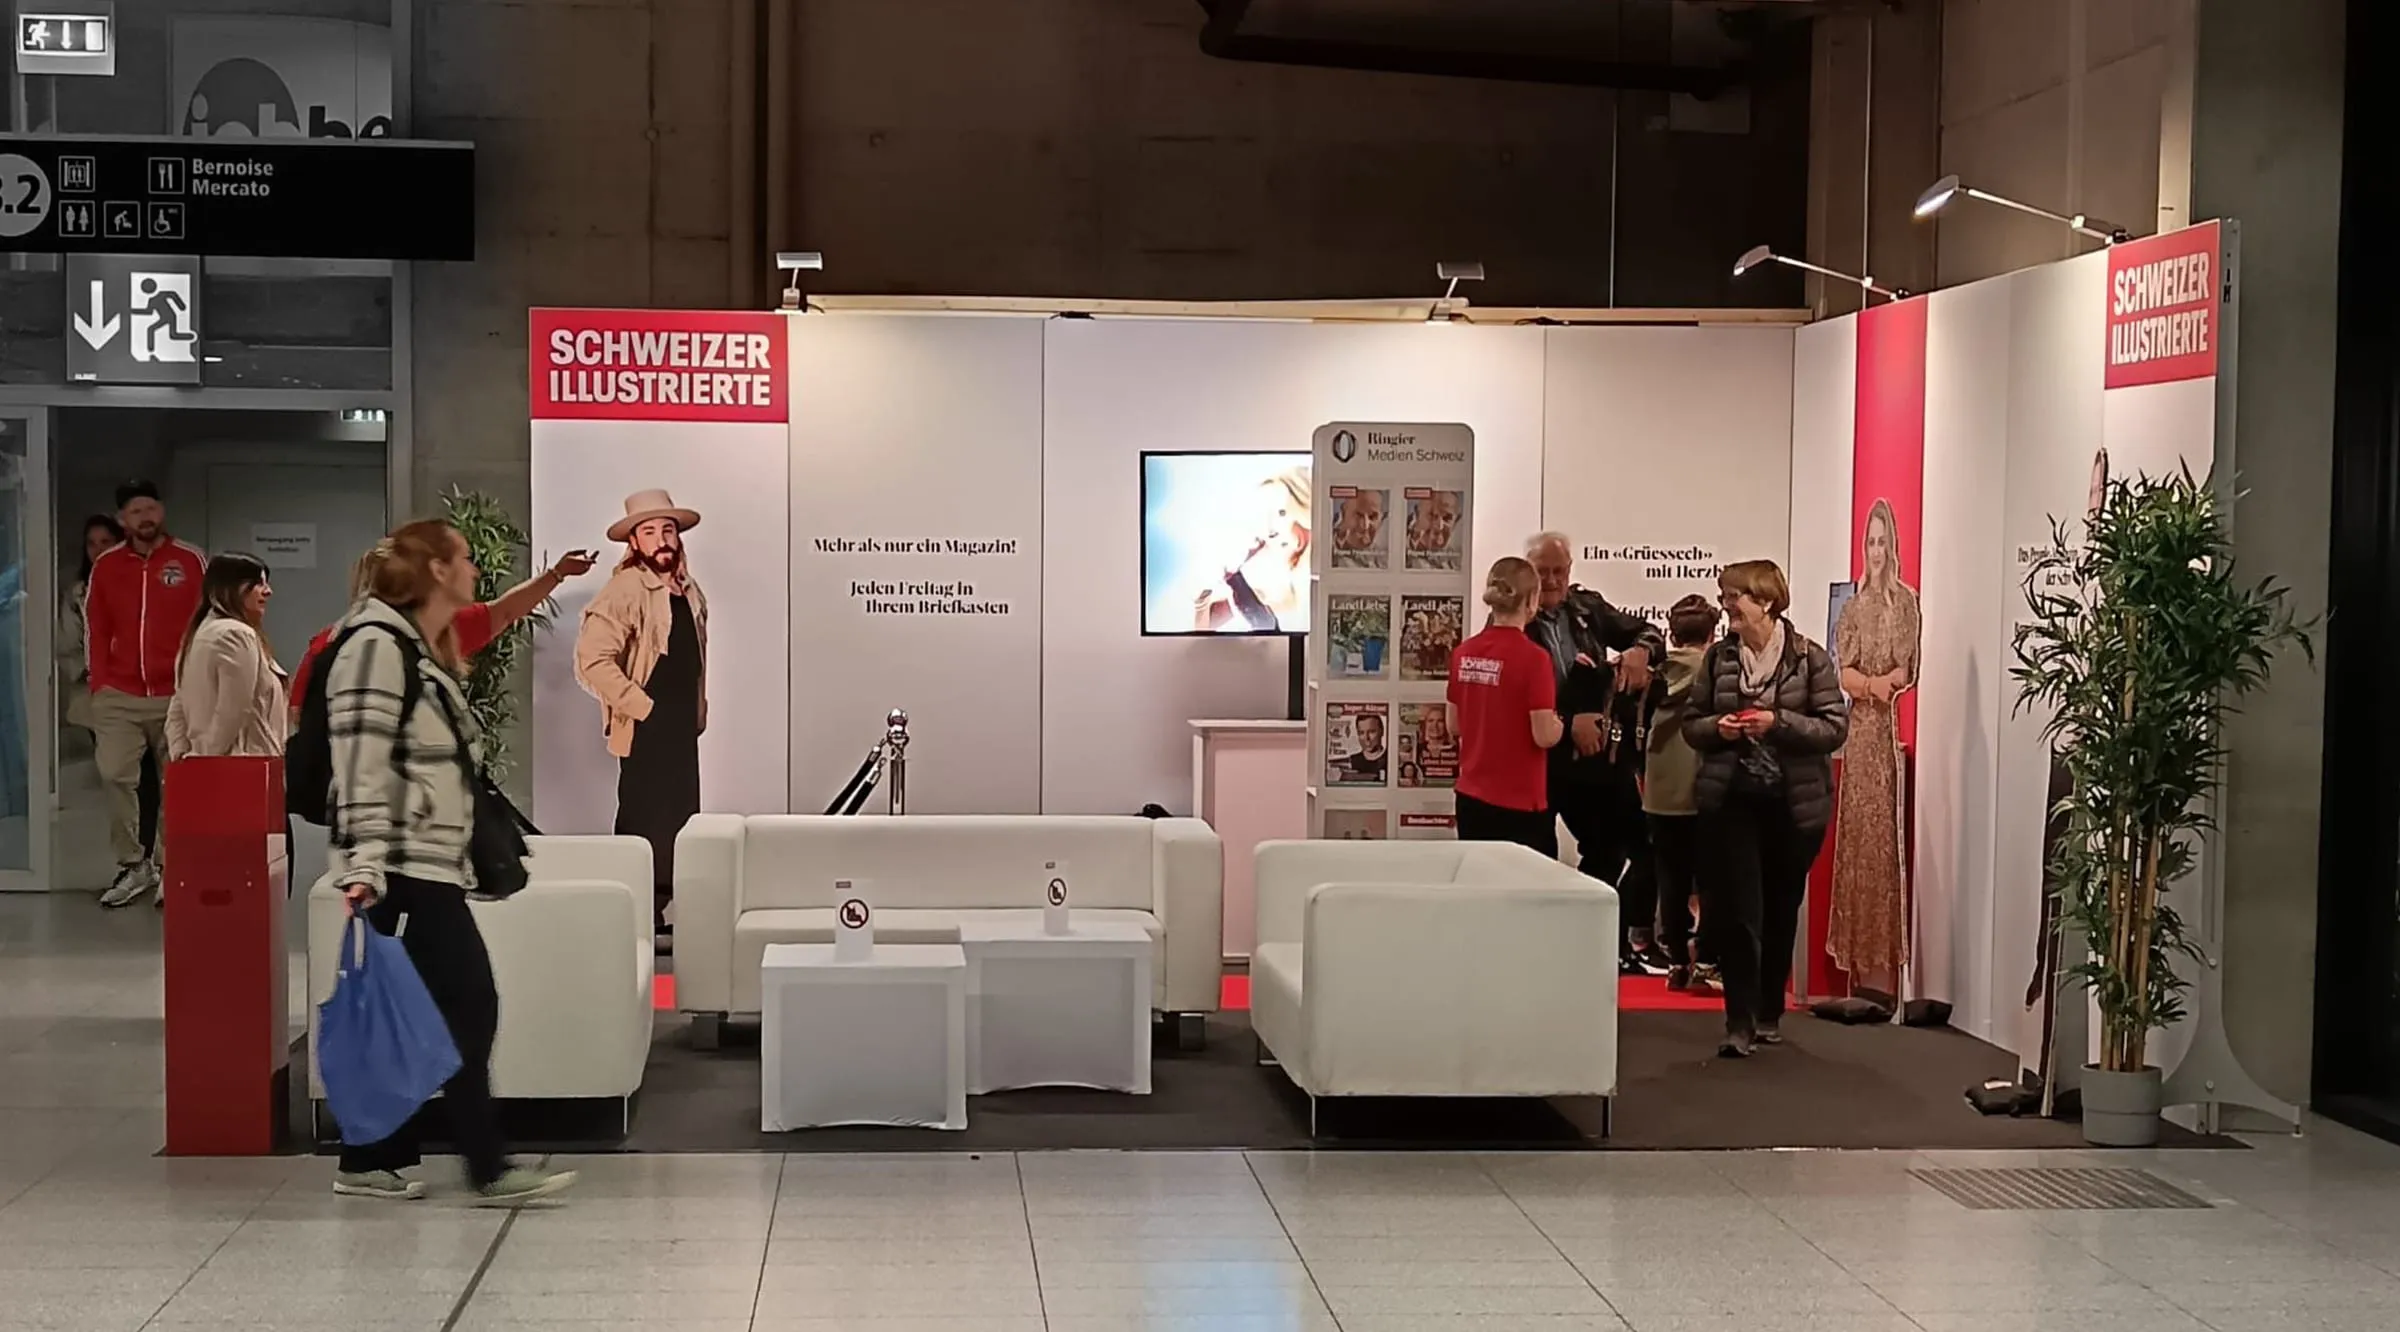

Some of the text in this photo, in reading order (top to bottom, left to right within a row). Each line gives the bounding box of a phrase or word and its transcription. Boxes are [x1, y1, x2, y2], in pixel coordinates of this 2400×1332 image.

[192, 159, 274, 177] Bernoise
[0, 174, 42, 214] .2
[192, 179, 270, 197] Mercato
[2113, 252, 2210, 316] SCHWEIZER
[2111, 308, 2209, 365] ILLUSTRIERTE
[550, 329, 771, 369] SCHWEIZER
[549, 370, 771, 406] ILLUSTRIERTE
[1367, 432, 1416, 447] Ringier
[1367, 450, 1466, 462] Medien Schweiz
[815, 538, 1017, 556] Mehr als nur ein Magazin!
[1584, 546, 1609, 560] Ein
[1646, 565, 1672, 578] mit
[851, 581, 973, 597] Jeden Freitag in
[866, 600, 1009, 614] Ihrem Briefkasten
